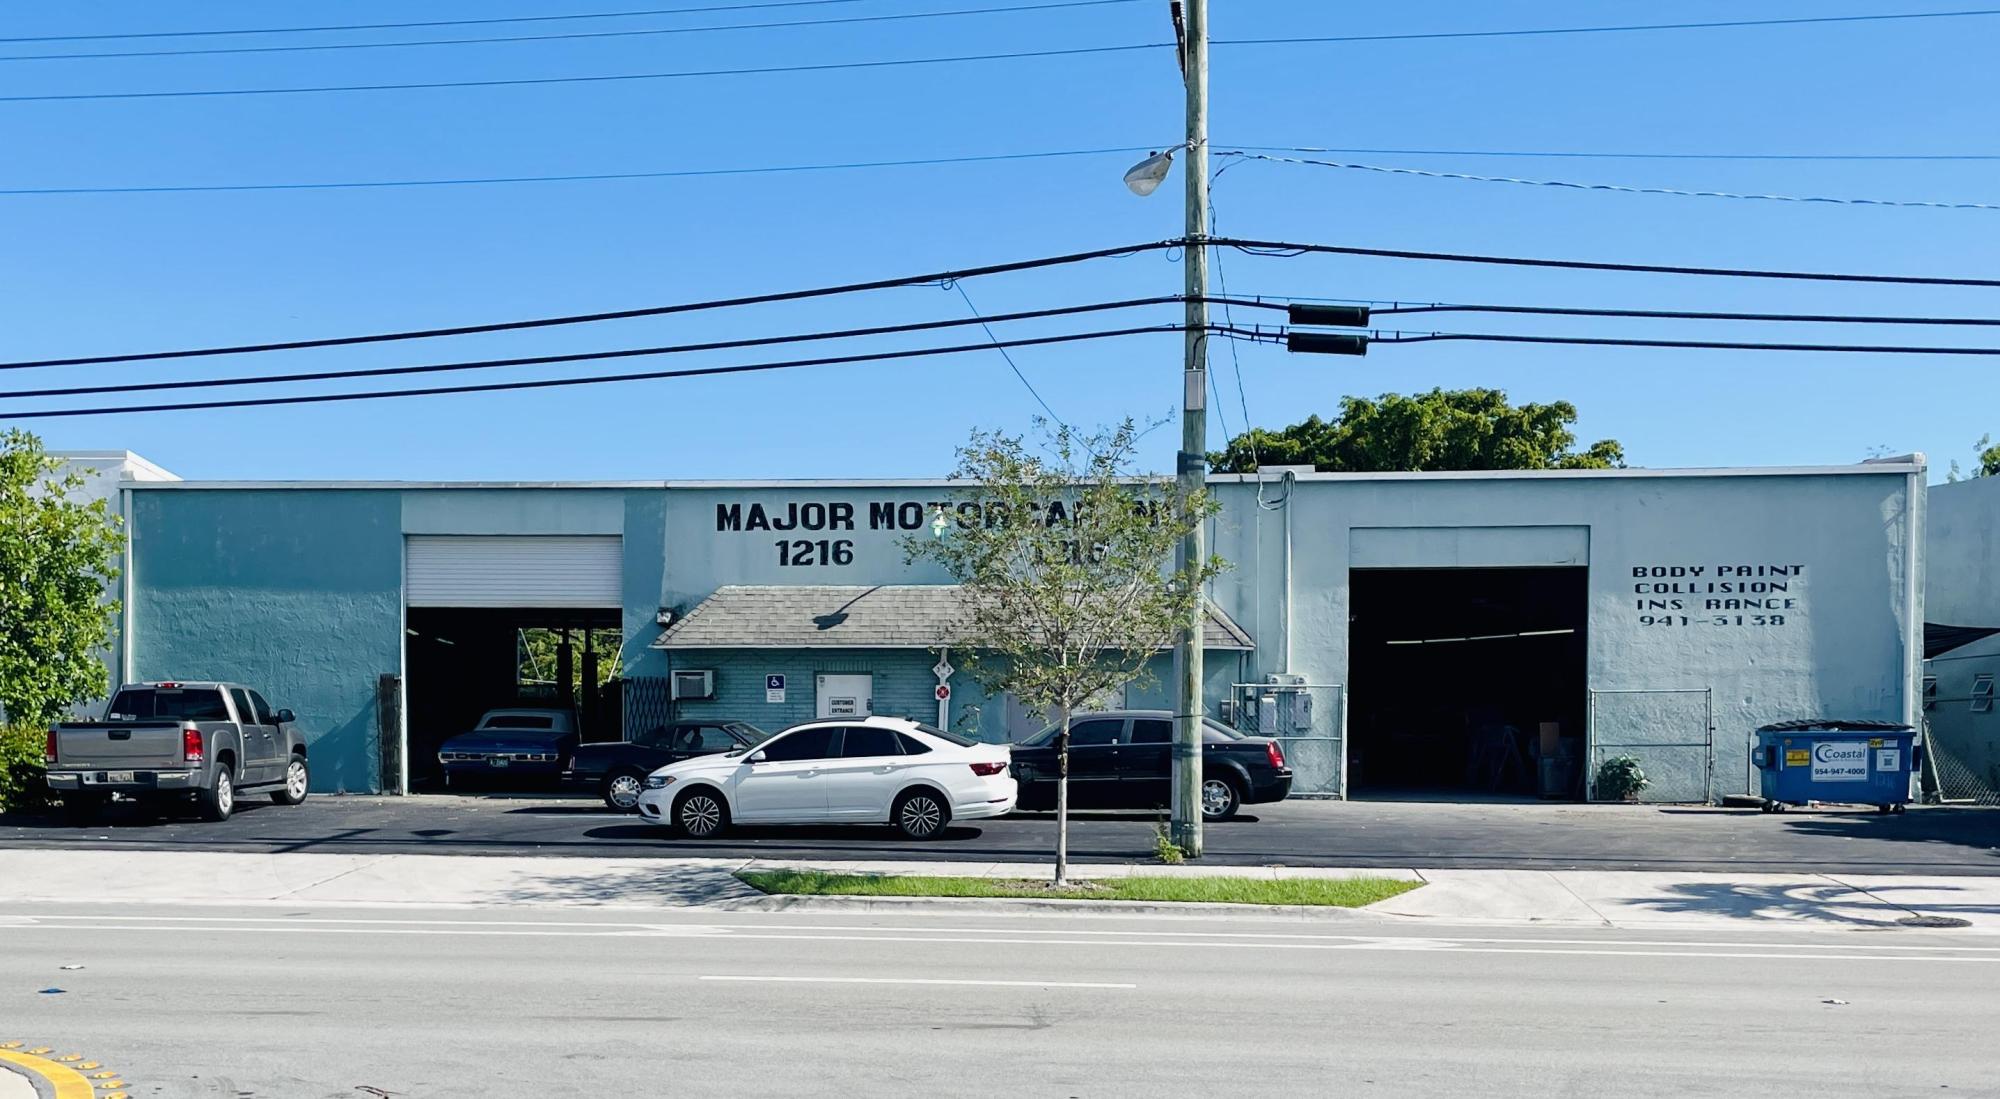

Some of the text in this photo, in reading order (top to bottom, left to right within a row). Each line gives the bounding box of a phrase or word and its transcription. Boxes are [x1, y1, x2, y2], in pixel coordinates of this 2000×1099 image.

[716, 502, 854, 531] MAJOR
[775, 539, 854, 566] 1216
[1632, 565, 1805, 578] BODY PAINT
[1634, 582, 1788, 594] COLLISION
[1639, 615, 1786, 627] 941-3138
[1824, 748, 1866, 758] Coastal
